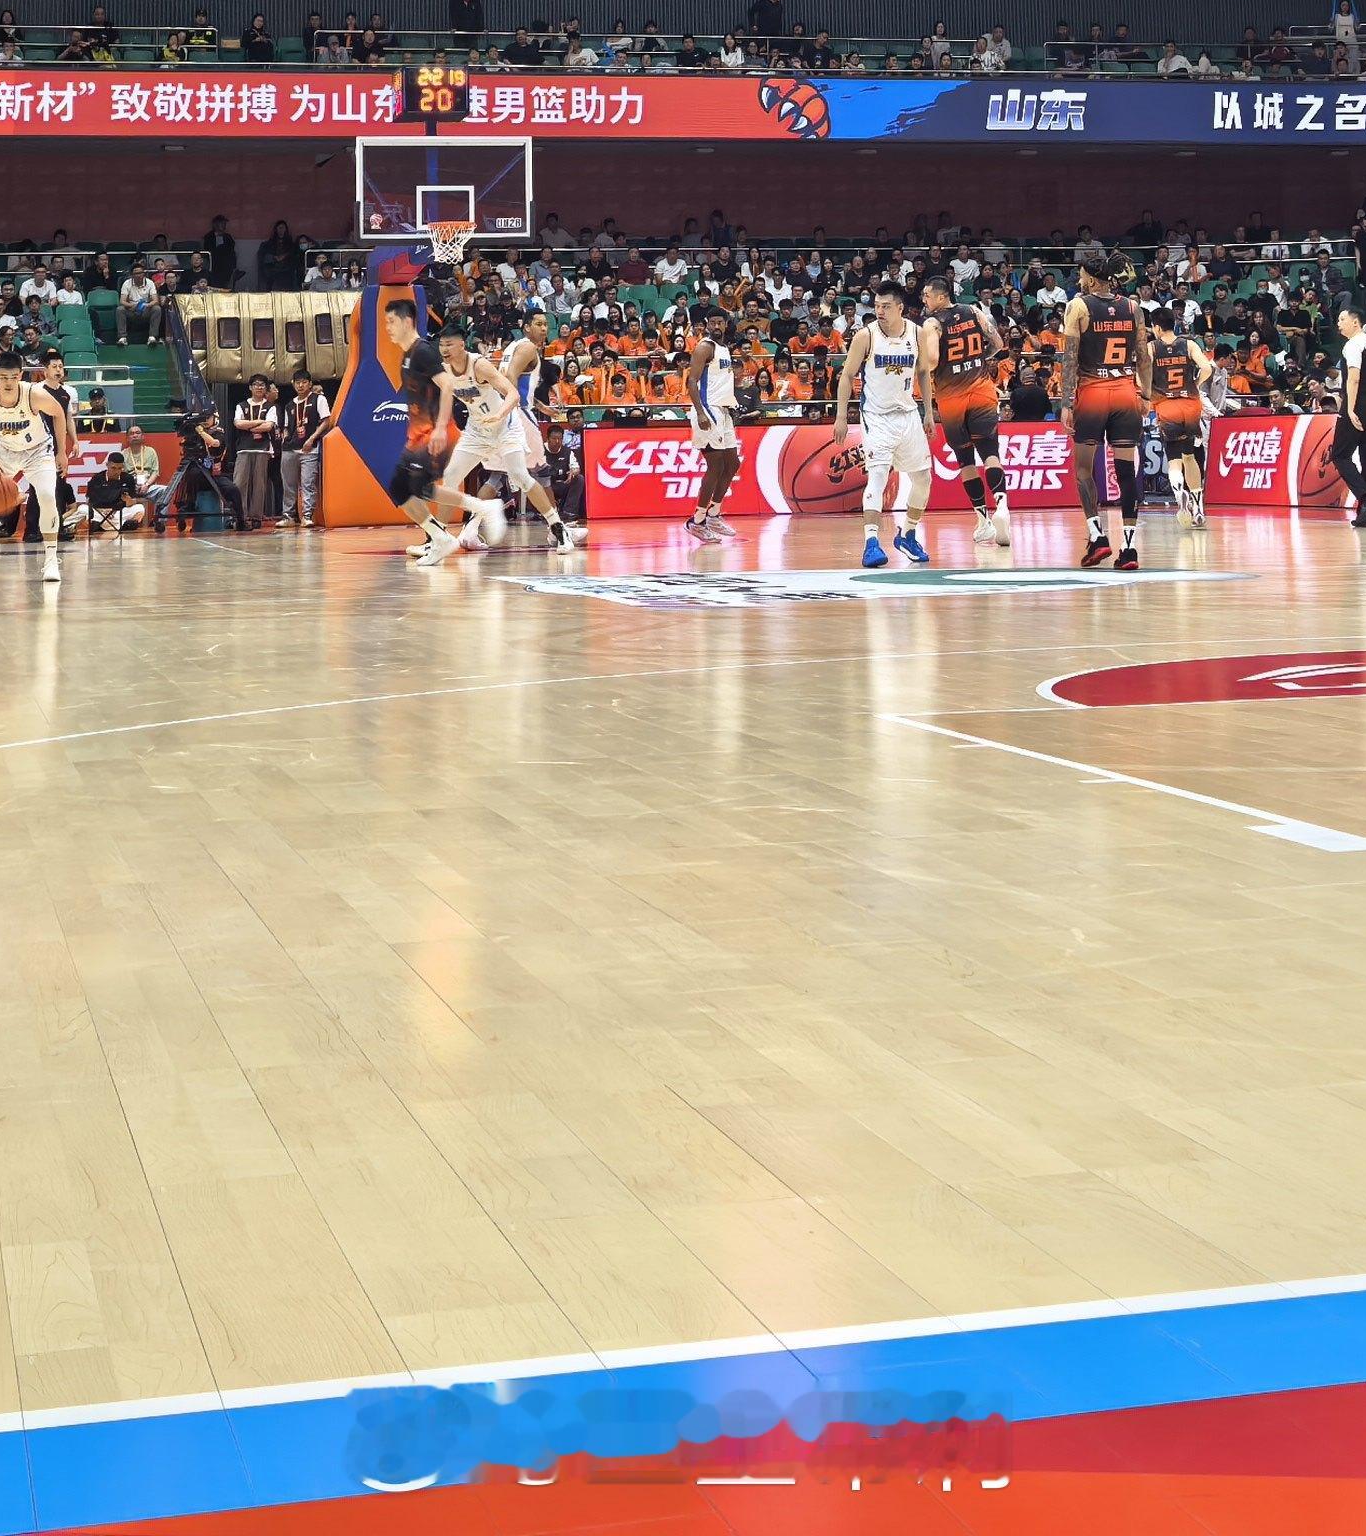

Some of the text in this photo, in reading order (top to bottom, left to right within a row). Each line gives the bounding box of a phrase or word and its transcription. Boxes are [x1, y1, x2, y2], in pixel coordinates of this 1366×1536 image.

[110, 80, 277, 124] 致敬拼搏
[420, 88, 452, 112] 20
[986, 88, 1087, 131] 山东
[947, 333, 983, 361] 20
[1104, 337, 1127, 364] 6
[1166, 369, 1184, 390] 5
[1225, 426, 1283, 464] 红双喜
[1243, 468, 1277, 489] DHS
